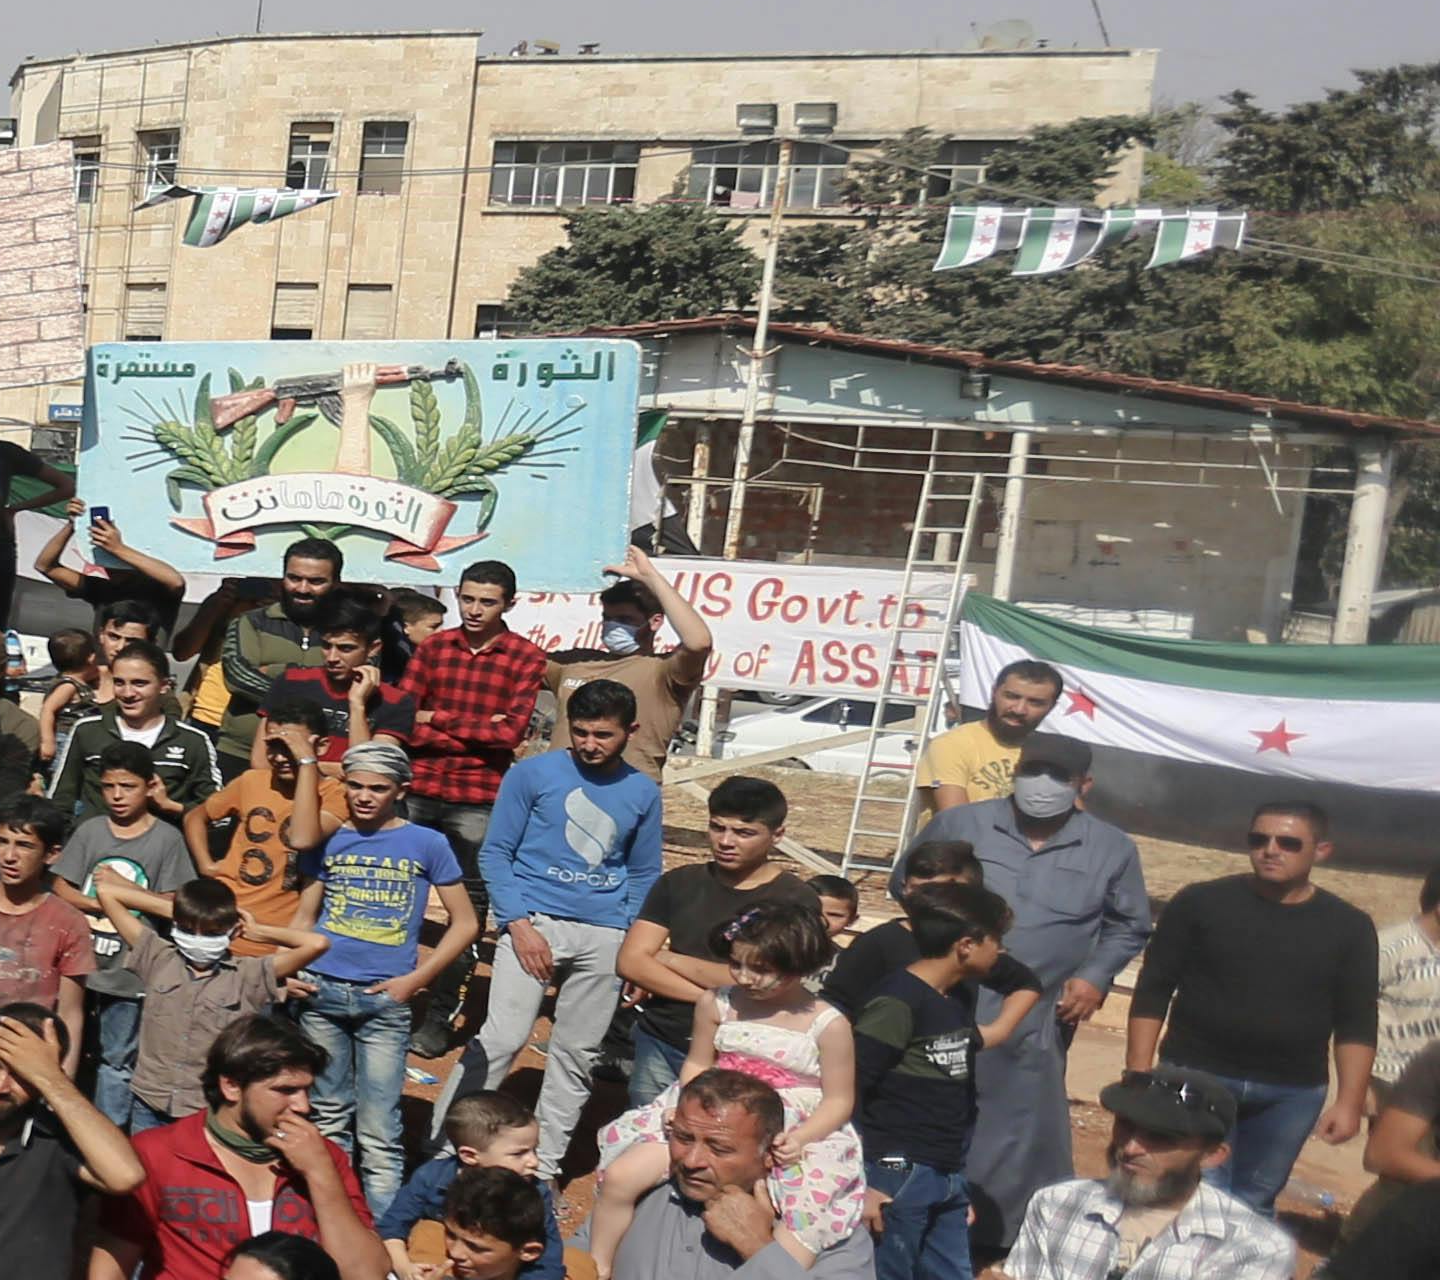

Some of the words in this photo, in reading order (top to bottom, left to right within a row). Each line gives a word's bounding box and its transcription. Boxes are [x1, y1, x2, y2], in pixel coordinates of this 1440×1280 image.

[96, 352, 196, 385] مستمرة
[492, 348, 616, 388] الثورة
[348, 483, 423, 533] الثورة
[747, 576, 872, 629] Govt.
[878, 592, 926, 629] to
[732, 643, 771, 680] of
[971, 758, 1014, 790] SUPE
